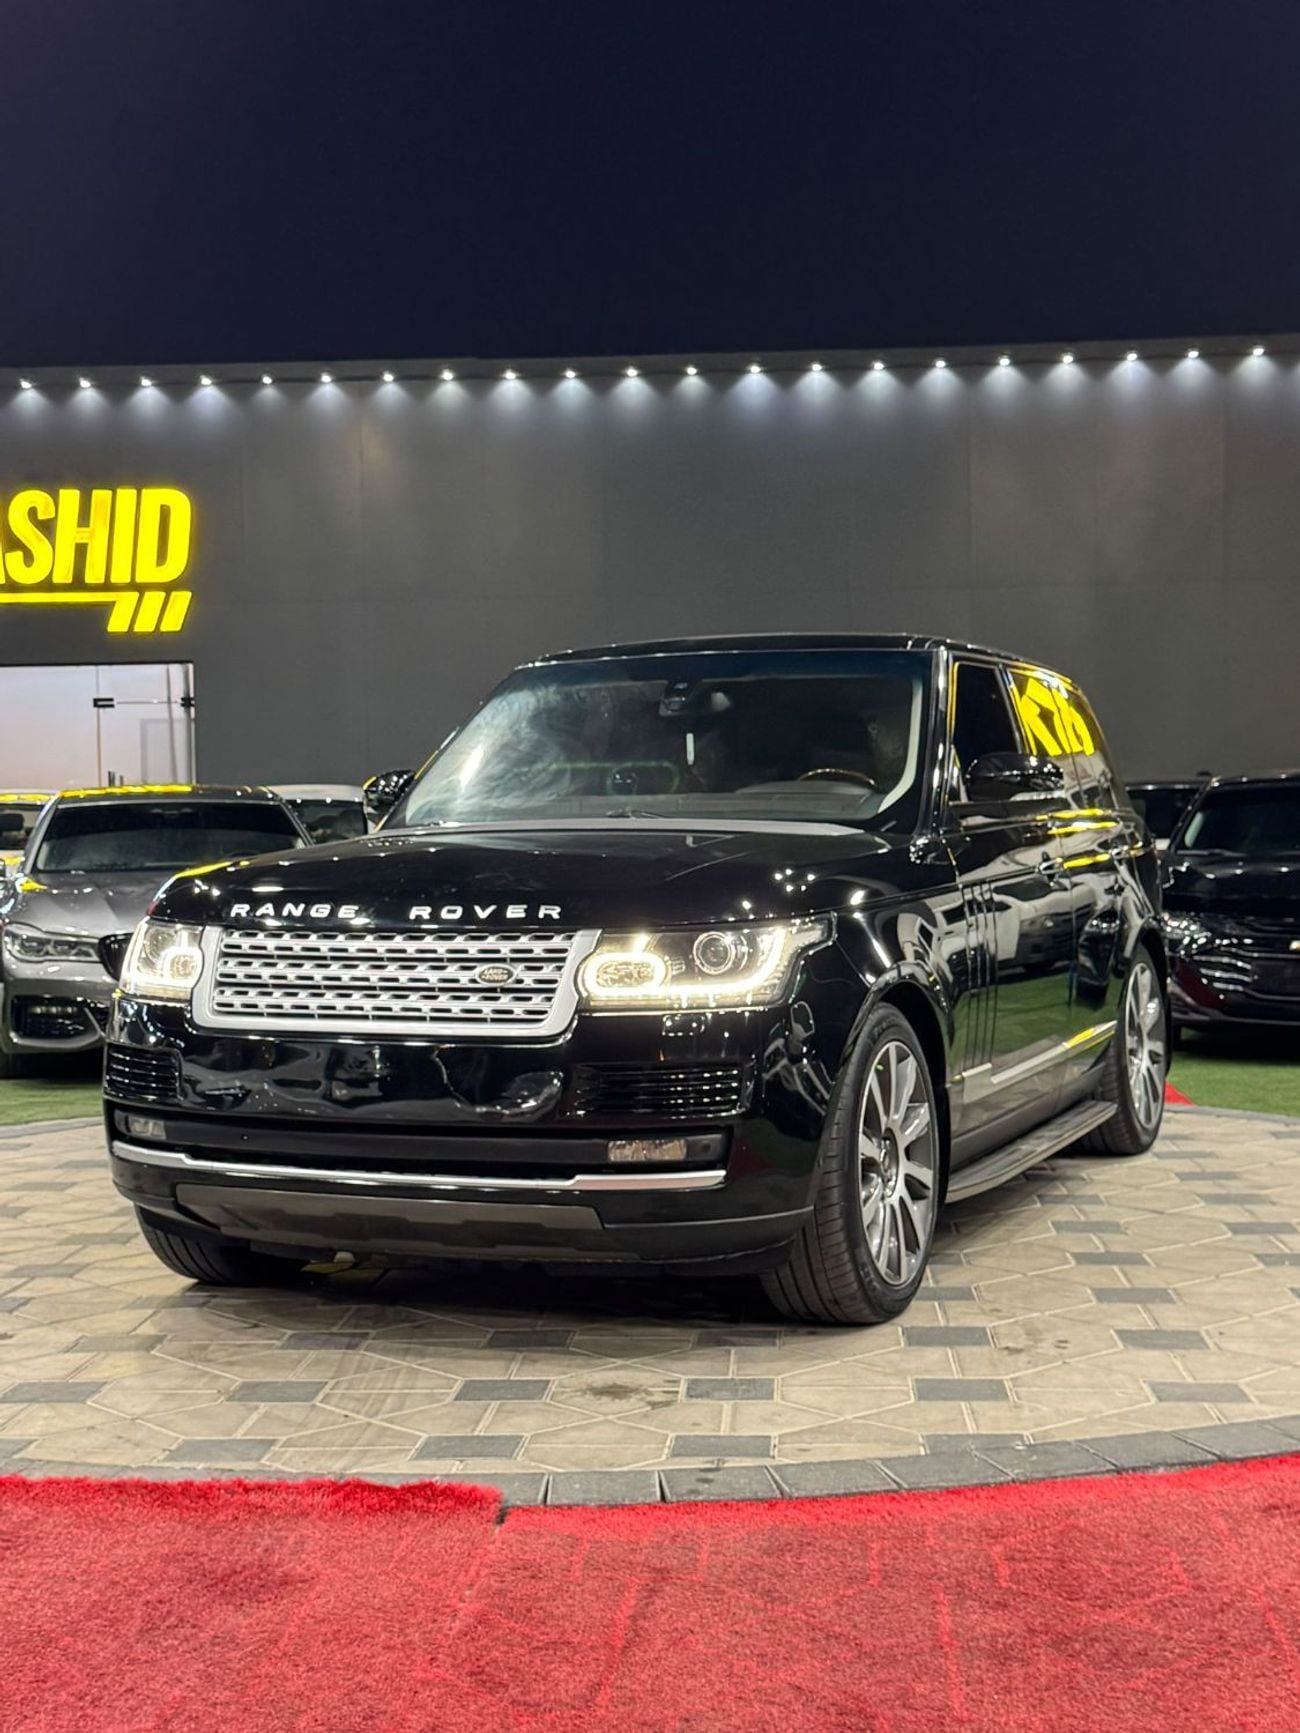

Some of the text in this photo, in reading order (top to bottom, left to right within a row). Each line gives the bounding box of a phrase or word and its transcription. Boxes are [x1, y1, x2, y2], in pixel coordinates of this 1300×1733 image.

[0, 488, 192, 584] SHID
[230, 902, 562, 920] RANGE ROVER
